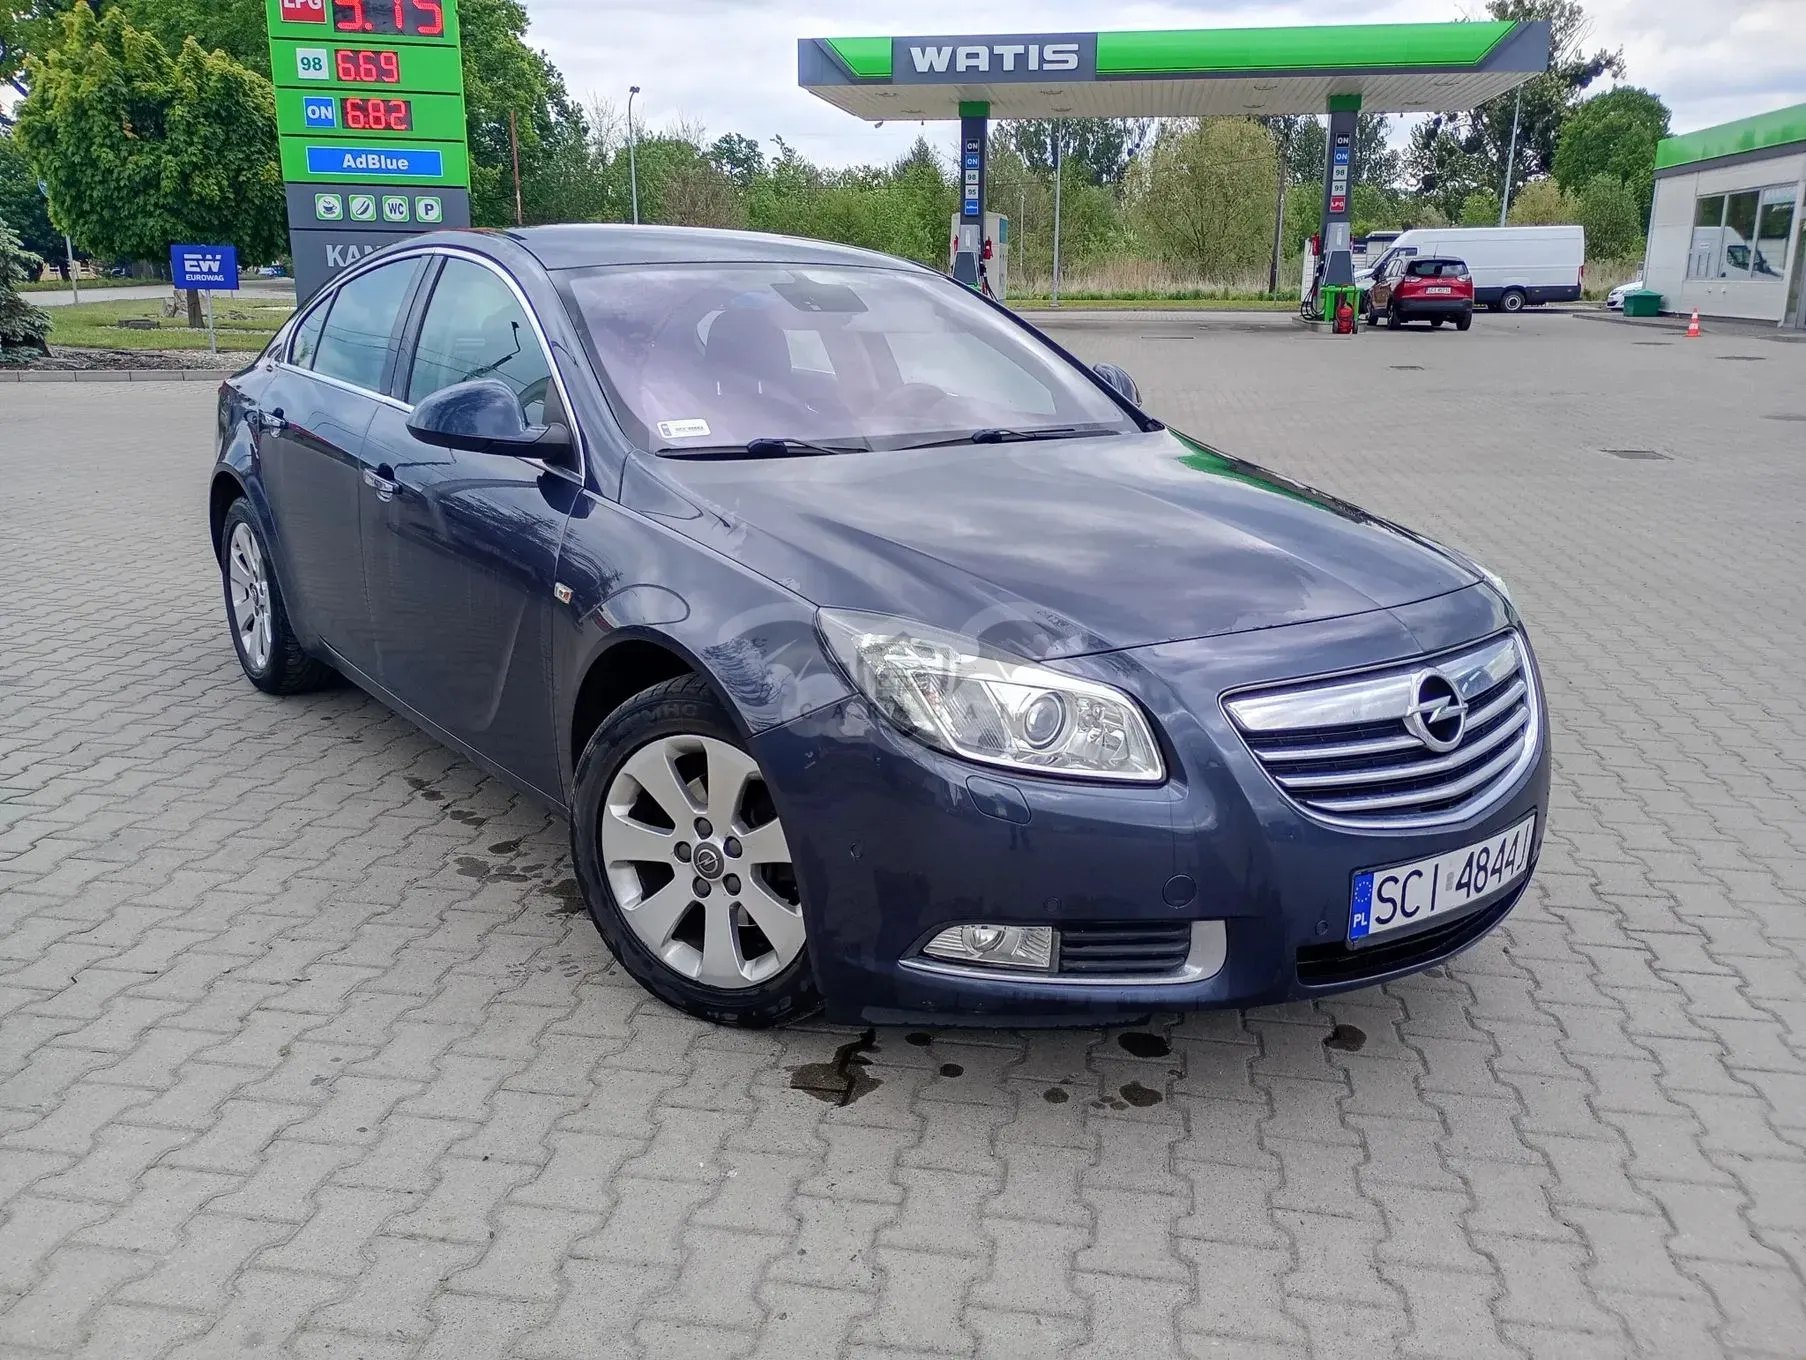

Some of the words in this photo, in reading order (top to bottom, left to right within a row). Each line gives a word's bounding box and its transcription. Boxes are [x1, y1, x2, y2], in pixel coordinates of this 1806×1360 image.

[300, 57, 323, 71] 98
[336, 50, 400, 83] 6.69
[909, 43, 1079, 73] WATIS
[306, 105, 333, 119] ON
[346, 97, 407, 130] 6.82
[967, 142, 978, 150] ON
[1337, 136, 1349, 144] ON
[342, 153, 409, 171] AdBlue
[388, 202, 404, 215] WC
[424, 203, 434, 216] P
[183, 253, 222, 272] EW
[1375, 863, 1439, 925] SCI
[1455, 823, 1531, 899] 4844J
[1353, 913, 1368, 929] PL
